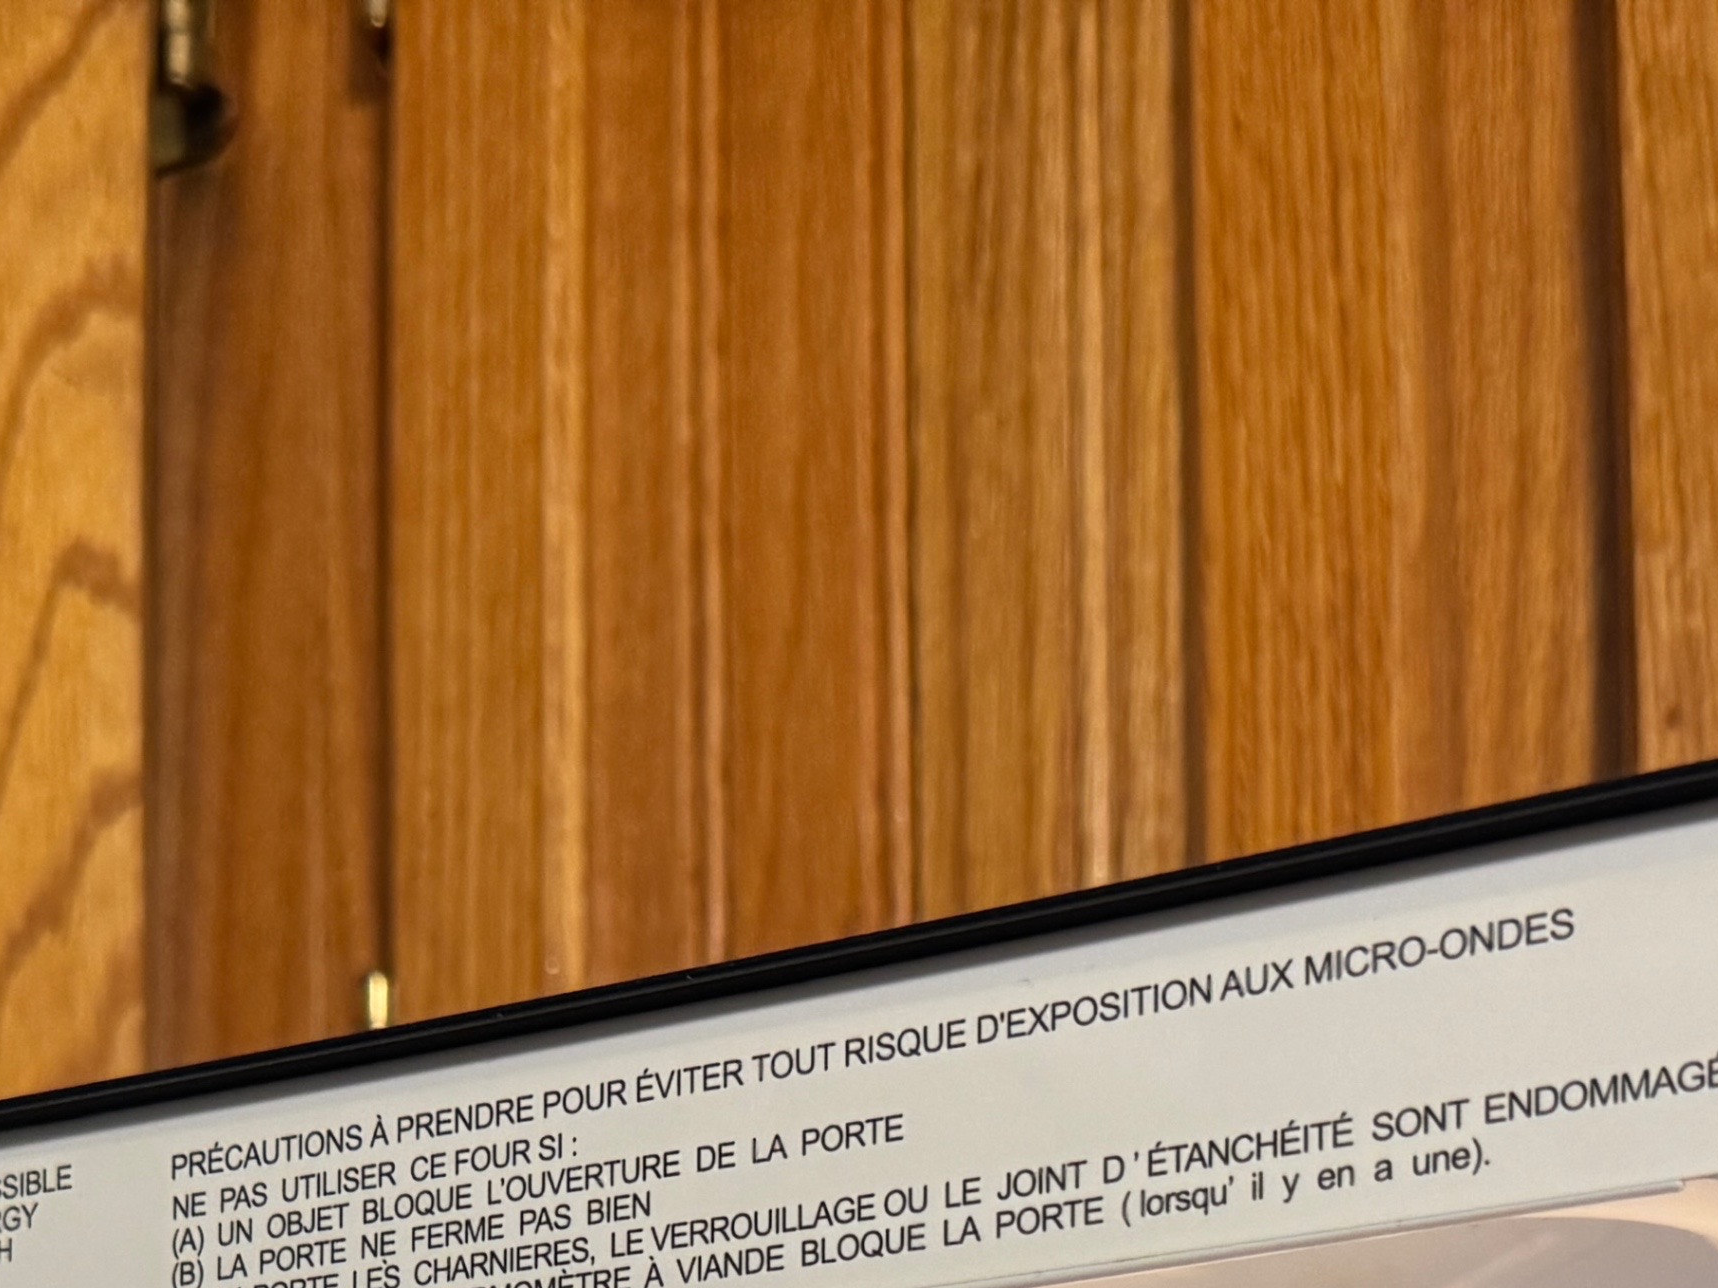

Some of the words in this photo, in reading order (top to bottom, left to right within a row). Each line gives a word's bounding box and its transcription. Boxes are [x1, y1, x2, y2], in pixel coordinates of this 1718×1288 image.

[170, 1123, 363, 1181] PRÉCAUTIONS
[369, 1113, 390, 1149] À
[396, 1093, 535, 1144] PRENDRE
[542, 1078, 628, 1120] POUR
[635, 1058, 745, 1104] ÉVITER
[750, 1041, 837, 1083] TOUT
[844, 1018, 967, 1068] RISQUE
[976, 973, 1213, 1045] D'EXPOSITION
[1219, 958, 1295, 1002] AUX
[1304, 907, 1575, 987] MICRO-ONDES
[171, 1224, 205, 1261] (A)
[217, 1217, 253, 1247] UN
[266, 1201, 350, 1240] OBJET
[362, 1182, 473, 1226] BLOQUE
[486, 1149, 681, 1207] L'OUVERTURE
[696, 1140, 736, 1174] DE
[751, 1133, 788, 1165] LA
[801, 1112, 904, 1157] PORTE
[172, 1190, 207, 1221] NE
[219, 1181, 268, 1214] PAS
[281, 1160, 397, 1204] UTILISER
[409, 1151, 447, 1183] CE
[454, 1138, 532, 1177] FOUR
[216, 1252, 248, 1282] LA
[259, 1236, 347, 1276] PORTE
[360, 1229, 397, 1261] NE
[411, 1212, 505, 1253] FERME
[519, 1203, 572, 1237] PAS
[586, 1190, 651, 1226] BIEN
[610, 1227, 644, 1259] LE
[650, 1192, 877, 1252] VERROUILLAGE
[883, 1184, 928, 1218] OU
[944, 1176, 982, 1210] LE
[996, 1159, 1088, 1201] JOINT
[1371, 1097, 1471, 1142] SONT
[675, 1243, 785, 1285] VIANDE
[800, 1222, 927, 1268] BLOQUE
[942, 1215, 982, 1248] LA
[995, 1195, 1104, 1240] PORTE
